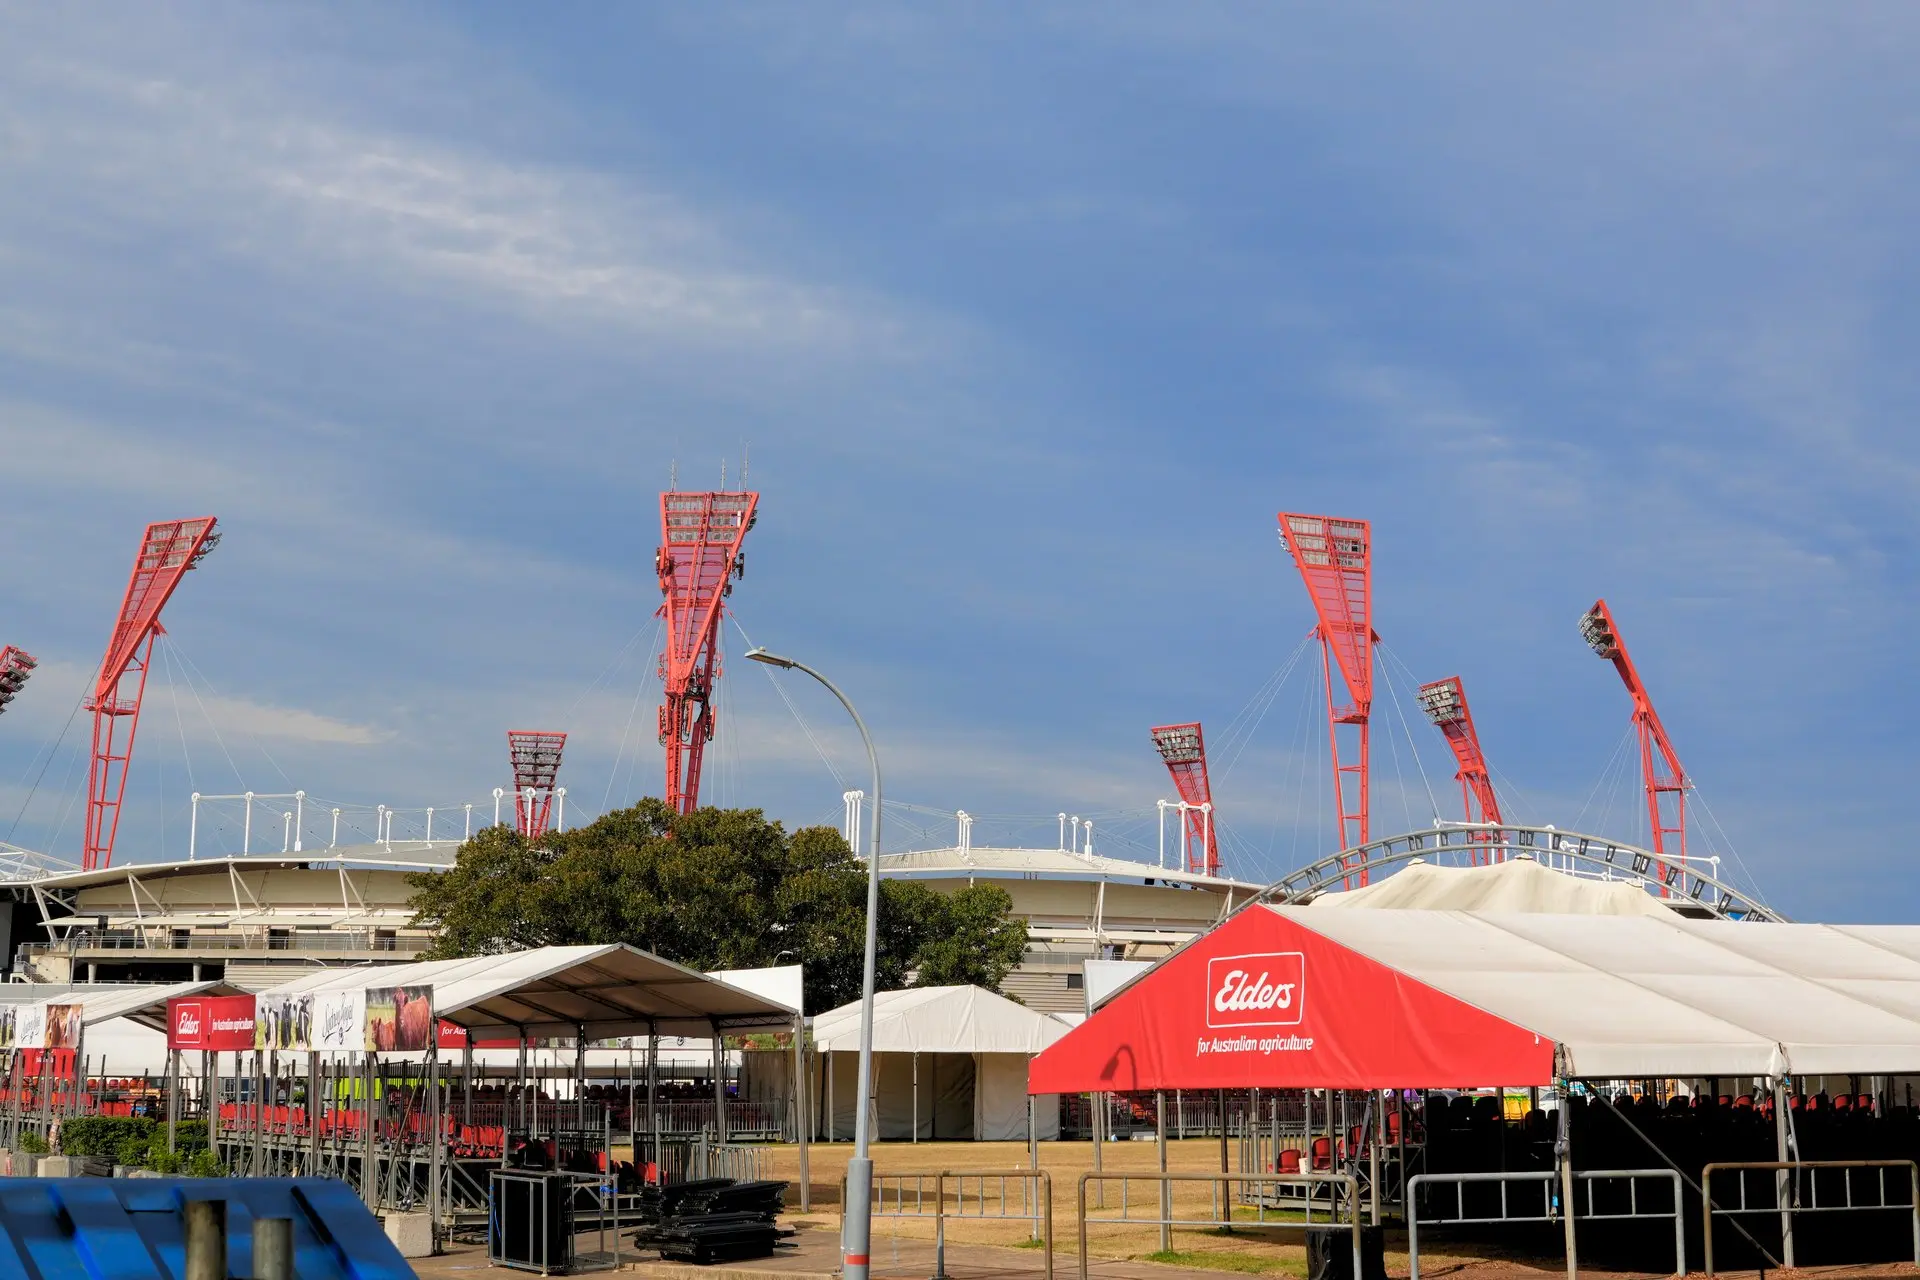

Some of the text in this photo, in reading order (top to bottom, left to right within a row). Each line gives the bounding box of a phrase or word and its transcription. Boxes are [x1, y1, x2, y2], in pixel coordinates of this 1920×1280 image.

[1215, 970, 1295, 1012] Elders
[178, 1011, 200, 1034] Elders
[442, 1026, 453, 1036] for
[1196, 1034, 1314, 1057] for Australian agriculture
